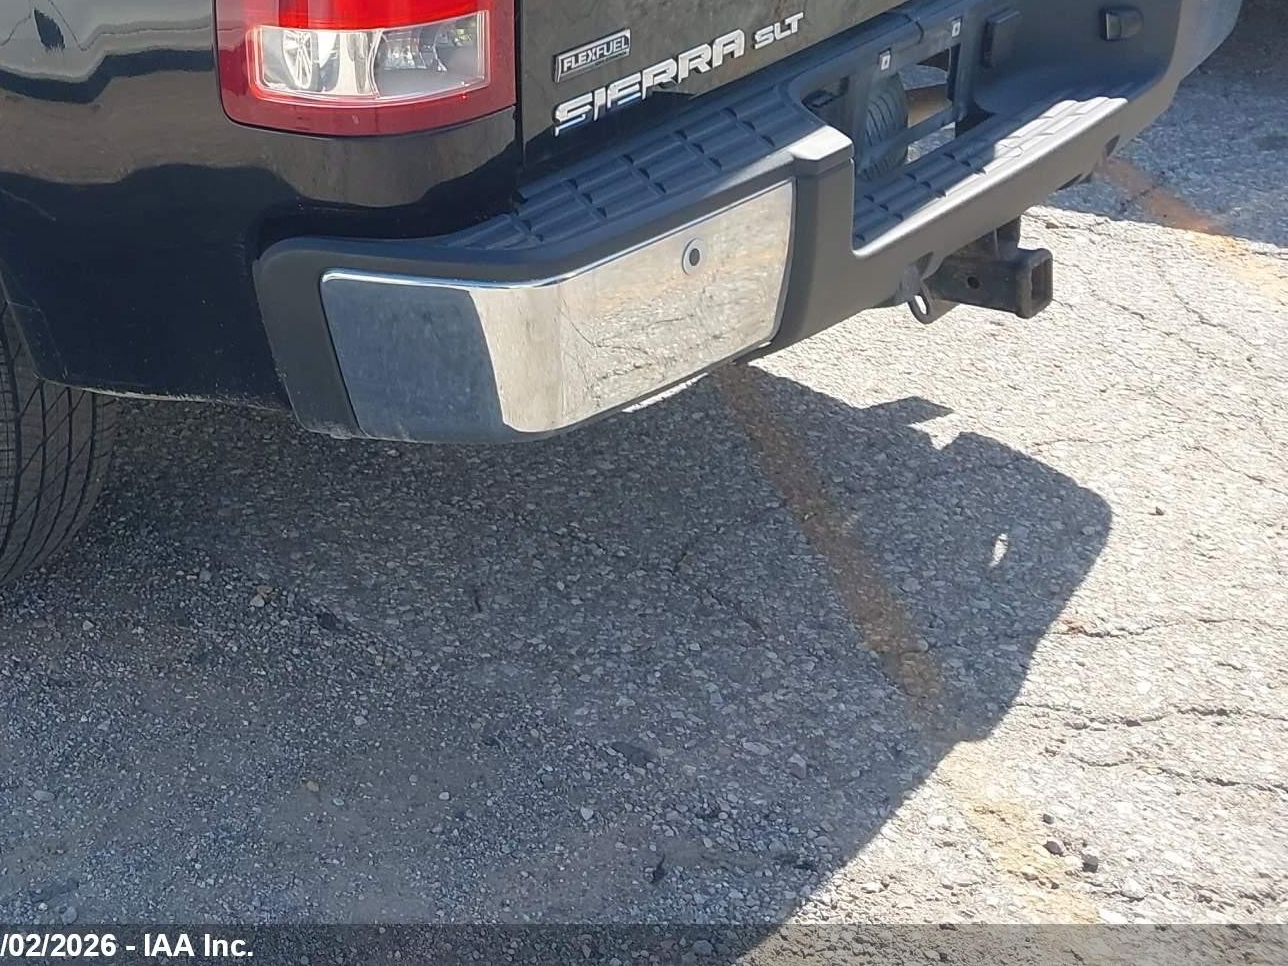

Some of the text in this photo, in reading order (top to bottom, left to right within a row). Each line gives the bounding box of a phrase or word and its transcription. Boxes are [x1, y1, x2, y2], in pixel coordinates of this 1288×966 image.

[554, 11, 804, 137] SIERRA SLT
[563, 36, 629, 73] FLEXFUEL
